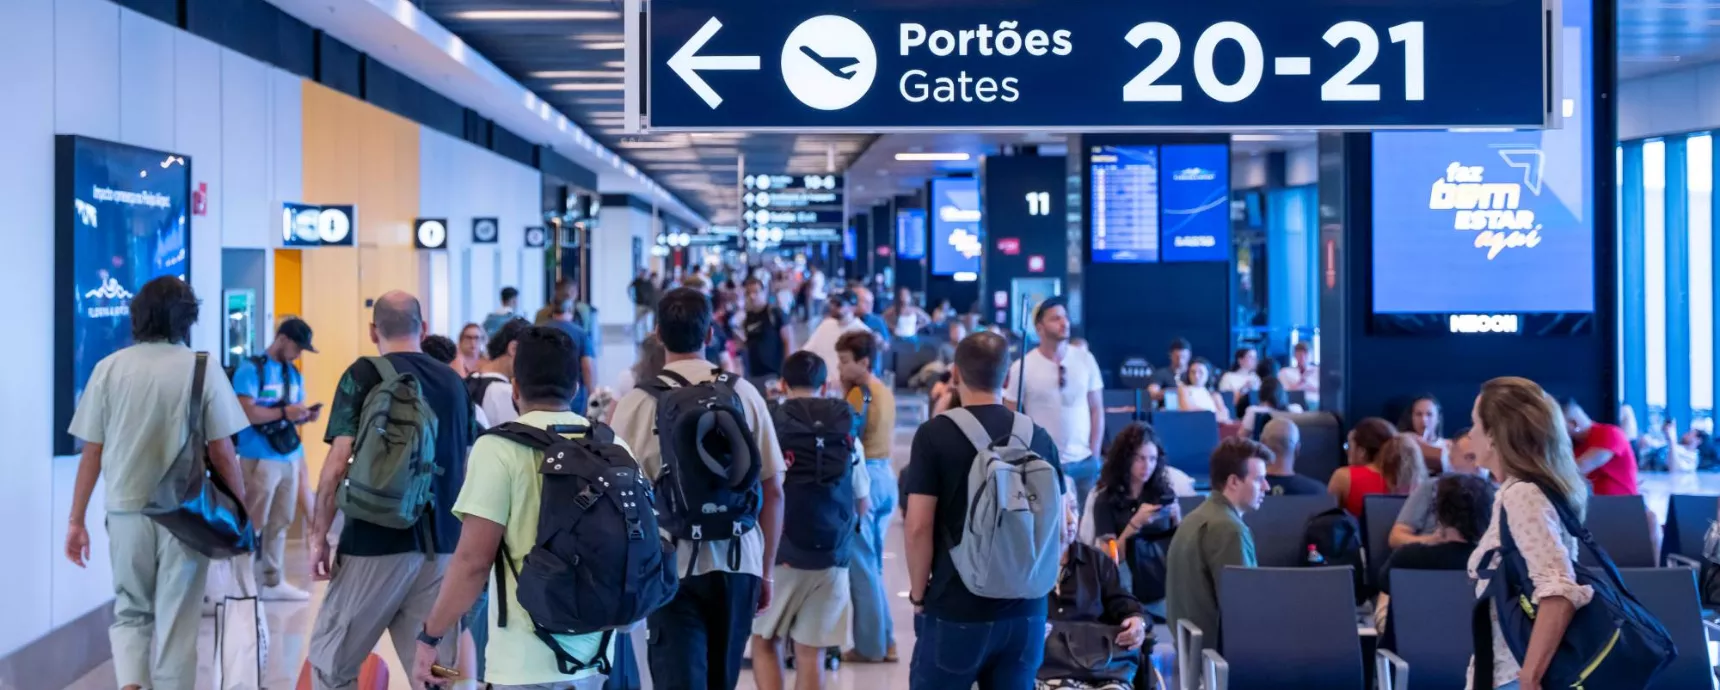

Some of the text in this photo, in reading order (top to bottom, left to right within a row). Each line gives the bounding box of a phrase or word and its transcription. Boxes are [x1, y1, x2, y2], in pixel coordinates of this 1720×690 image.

[901, 21, 1072, 55] Portões
[1123, 21, 1425, 102] 20-21
[900, 70, 1018, 102] Gates
[1026, 192, 1050, 215] 11
